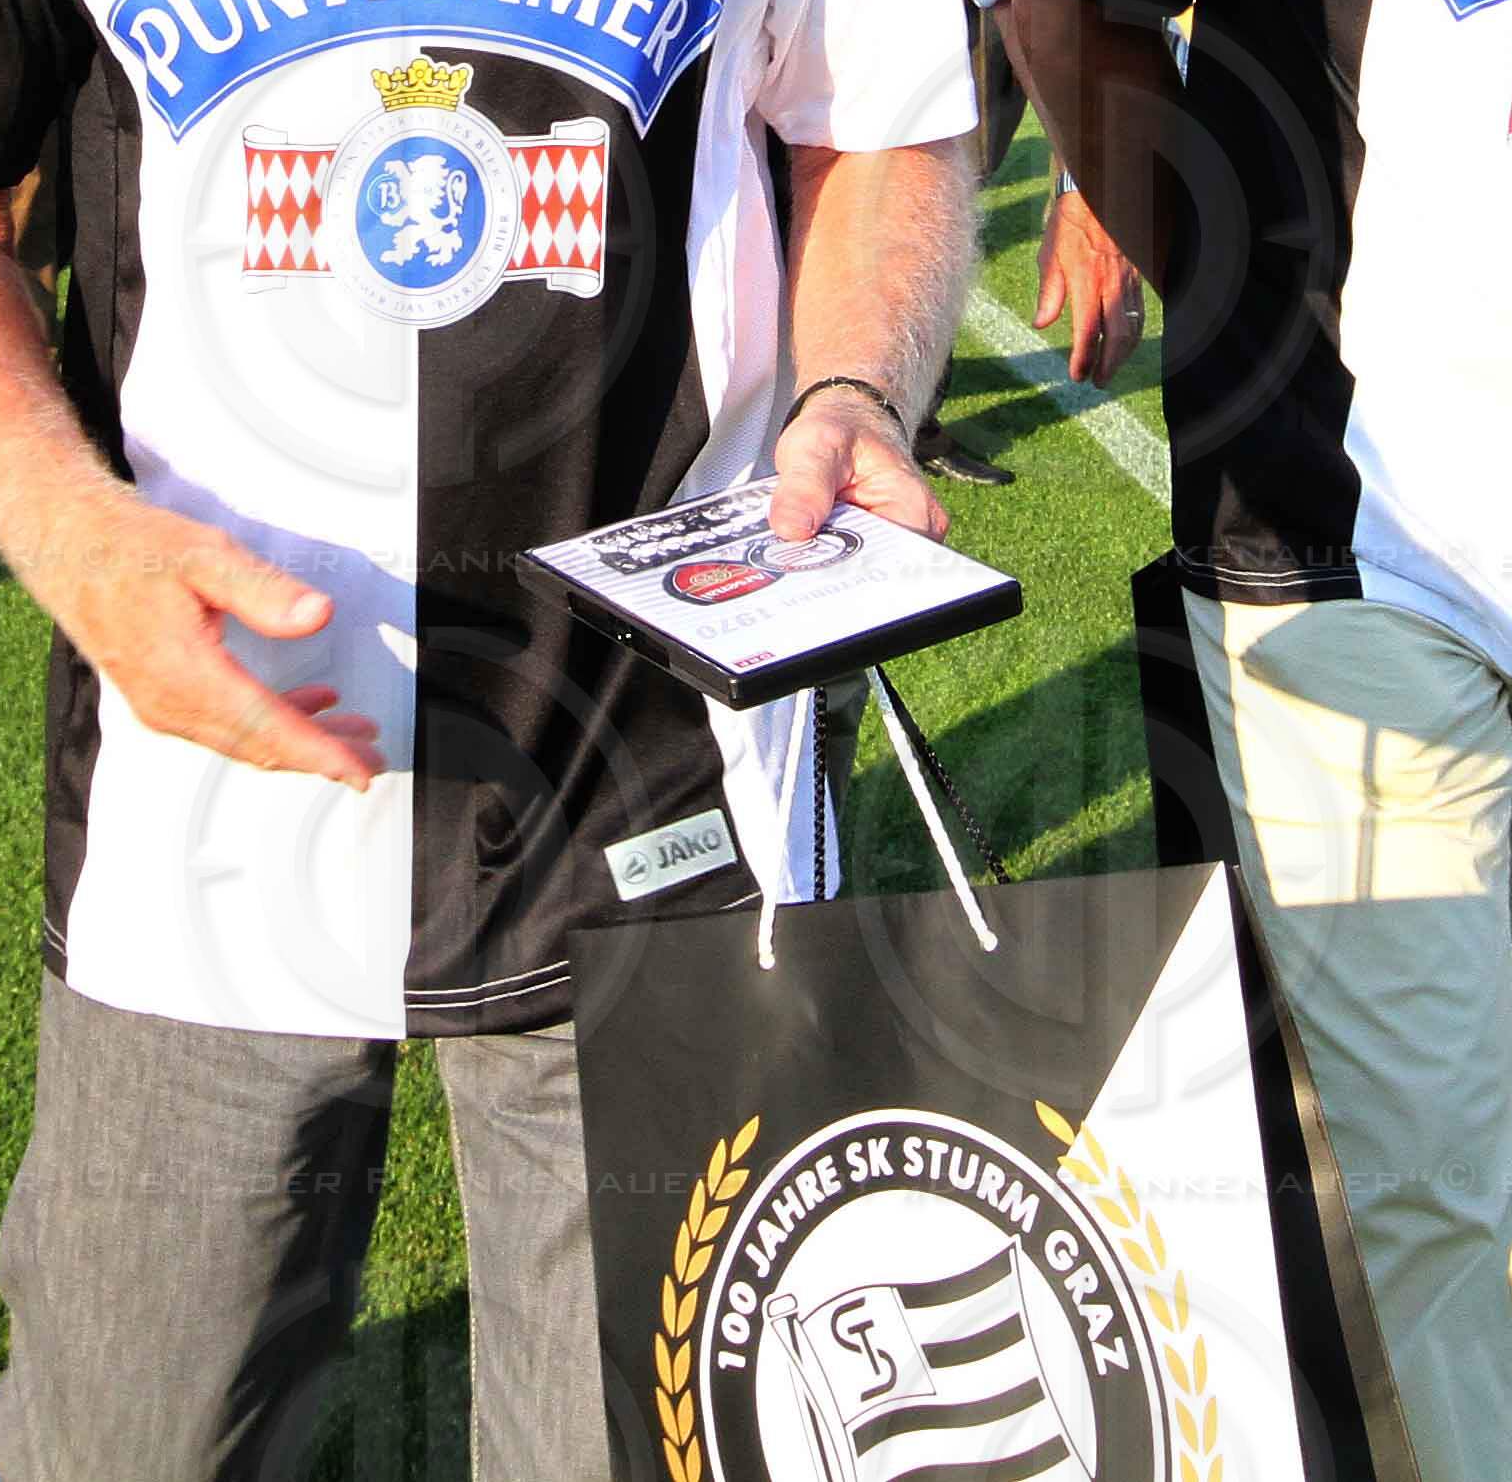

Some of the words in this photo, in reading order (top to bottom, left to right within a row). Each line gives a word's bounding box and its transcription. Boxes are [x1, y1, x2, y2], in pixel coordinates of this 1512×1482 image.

[655, 827, 722, 872] JAKO
[718, 1281, 758, 1371] 100
[745, 1156, 843, 1278] JAHRE
[845, 1136, 894, 1183] SK
[903, 1135, 1040, 1233] STURM
[1043, 1229, 1130, 1376] GRAZ
